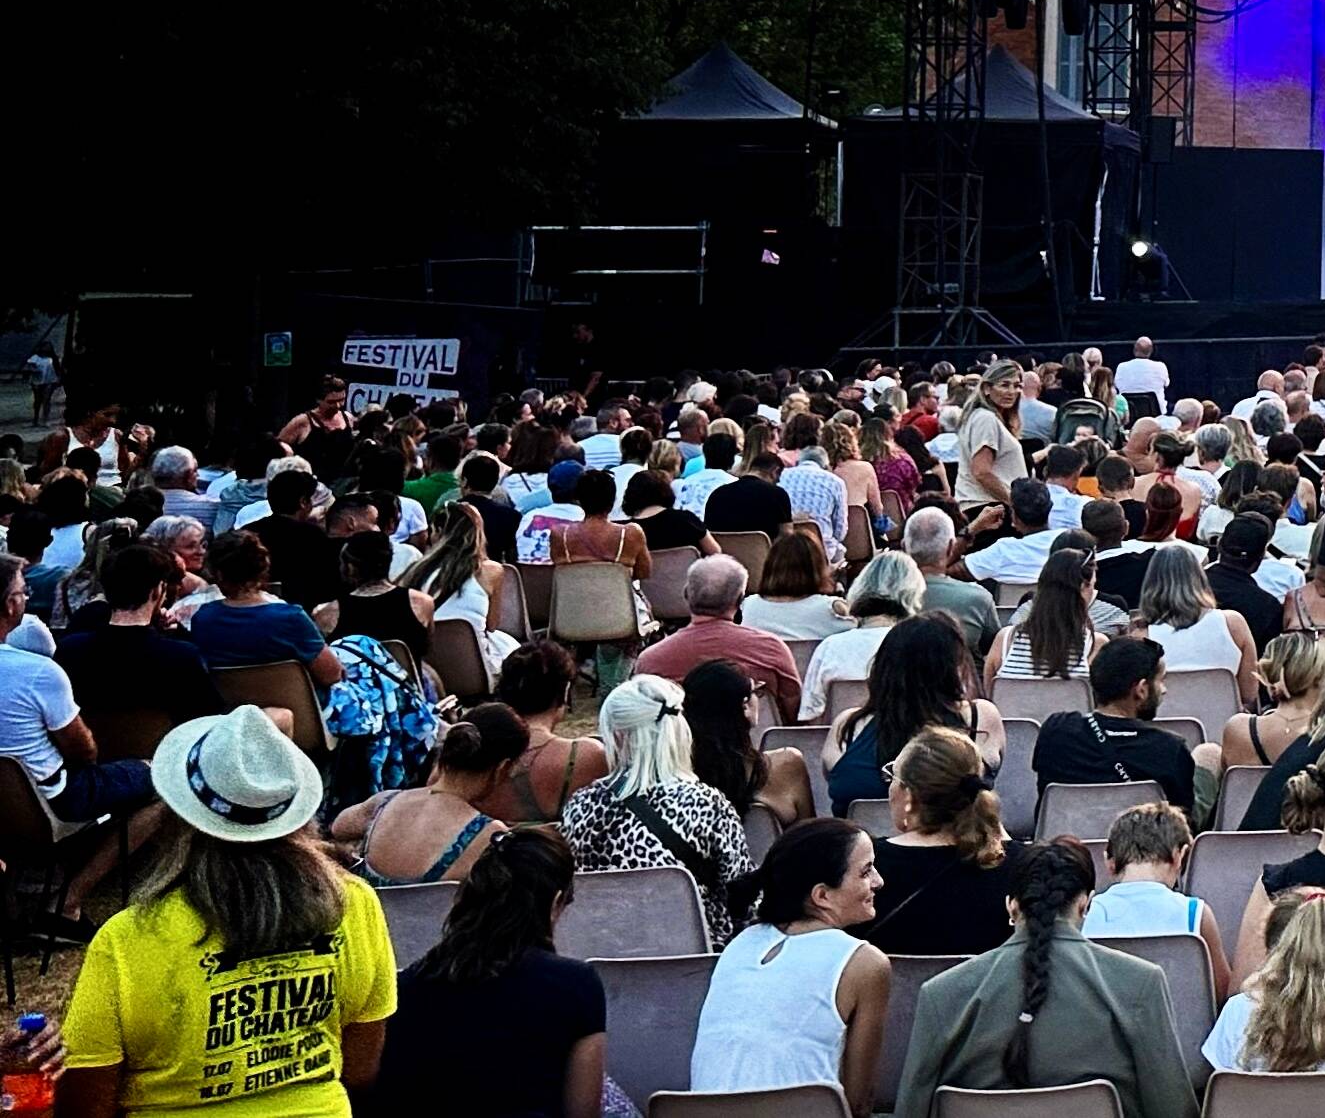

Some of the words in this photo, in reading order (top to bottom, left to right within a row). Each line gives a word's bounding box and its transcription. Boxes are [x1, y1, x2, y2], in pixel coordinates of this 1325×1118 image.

[344, 344, 454, 373] FESTIVAL
[399, 372, 424, 387] DU
[209, 970, 336, 1026] FESTIVAL
[206, 1021, 235, 1051] DU
[247, 1042, 295, 1069] ELODIE
